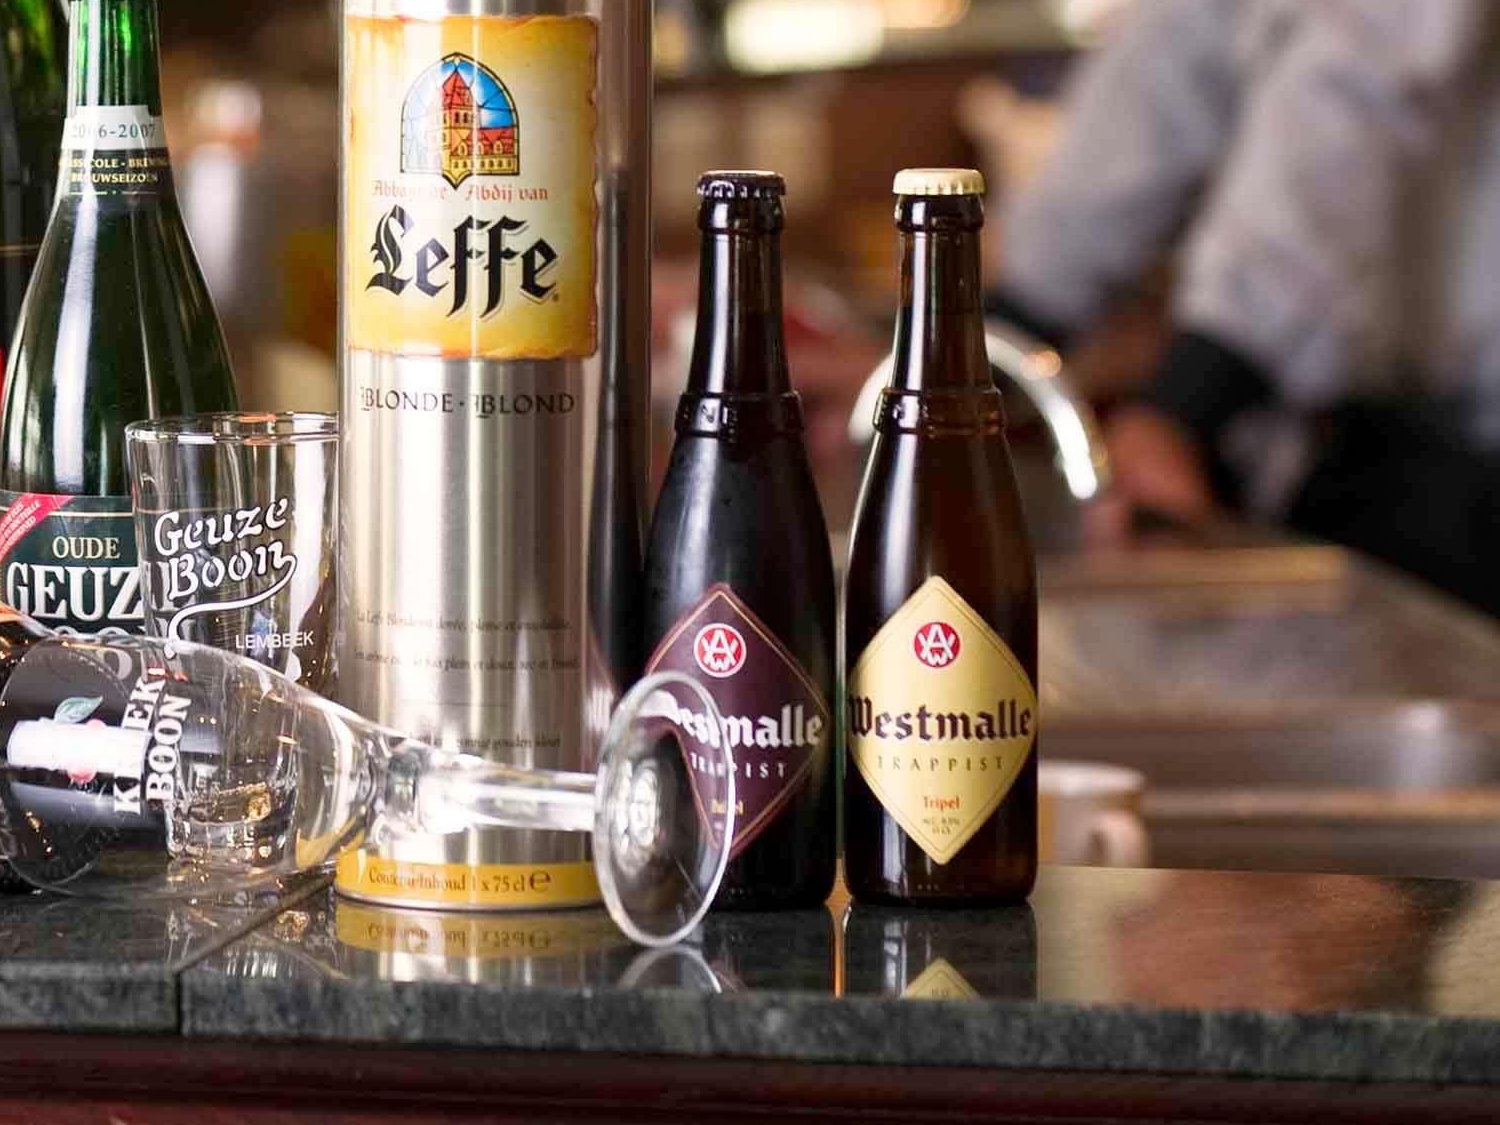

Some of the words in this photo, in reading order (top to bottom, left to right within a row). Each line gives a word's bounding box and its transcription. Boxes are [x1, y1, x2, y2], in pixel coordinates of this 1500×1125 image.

[71, 123, 157, 139] 206-2007
[366, 205, 558, 318] Leffe
[361, 387, 453, 412] BLONDE
[474, 393, 576, 418] BLOND
[154, 498, 288, 556] Geuze
[52, 536, 121, 559] OUDE
[167, 541, 298, 603] Boon
[235, 631, 315, 649] LEMBEEK
[676, 704, 822, 748] estmalle
[847, 691, 1032, 741] Westmalle
[145, 693, 193, 801] BOON
[876, 755, 1004, 772] TRAPPIST
[493, 875, 510, 891] 75
[513, 875, 526, 891] cl
